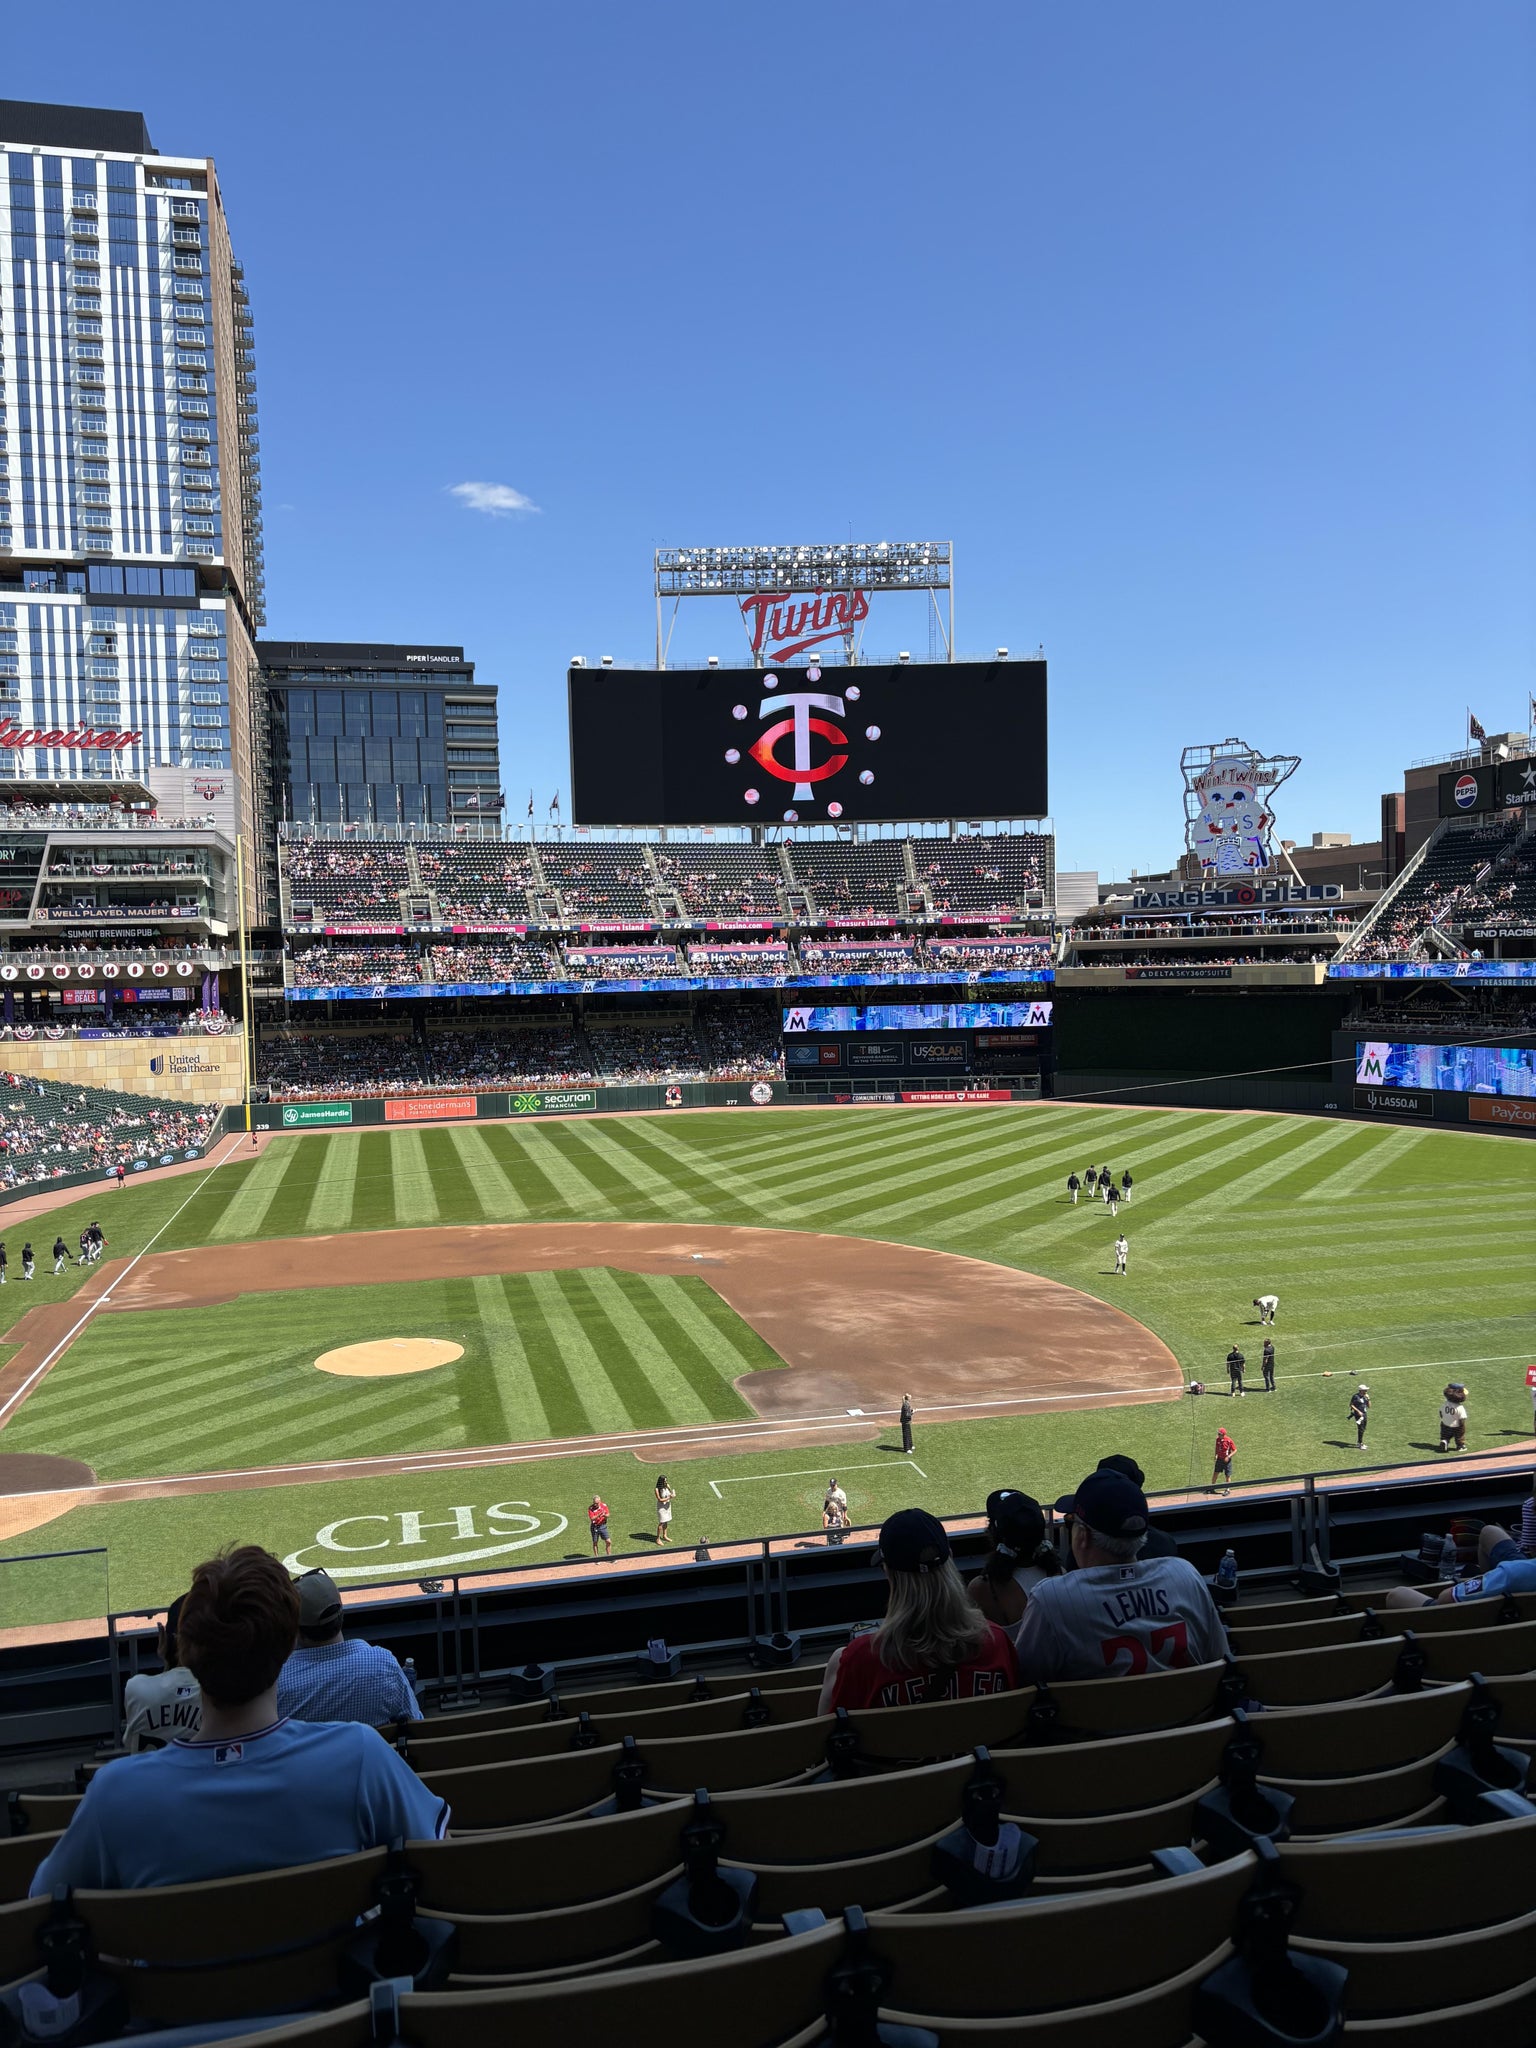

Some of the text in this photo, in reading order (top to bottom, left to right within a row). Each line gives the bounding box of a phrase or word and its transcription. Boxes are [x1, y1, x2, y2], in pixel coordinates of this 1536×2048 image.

[740, 586, 869, 656] Twins
[1193, 767, 1278, 791] Win! Twins!
[1456, 787, 1477, 796] PEPSI
[1134, 885, 1342, 908] TARGET FIELD
[82, 909, 126, 917] PLAYED,
[68, 928, 152, 938] SUMMIT BREWING PUB
[762, 952, 786, 960] Deck
[875, 949, 906, 958] sland
[6, 968, 12, 977] 7
[31, 968, 40, 976] 10
[80, 967, 92, 976] 34
[75, 994, 96, 1002] DEALS
[102, 1030, 127, 1038] GRAY
[169, 1055, 200, 1064] United
[170, 1064, 220, 1074] Healthcare
[1364, 1059, 1382, 1078] M
[544, 1094, 590, 1104] securian
[1379, 1096, 1418, 1108] LASSO.AI
[408, 1100, 471, 1111] Schneiderman's
[300, 1110, 349, 1118] JamesHardie
[1444, 1406, 1455, 1416] 00
[316, 1501, 541, 1551] CHS
[1102, 1587, 1170, 1628] LEWIS
[881, 1671, 1008, 1708] KEER
[146, 1703, 202, 1732] LEWI
